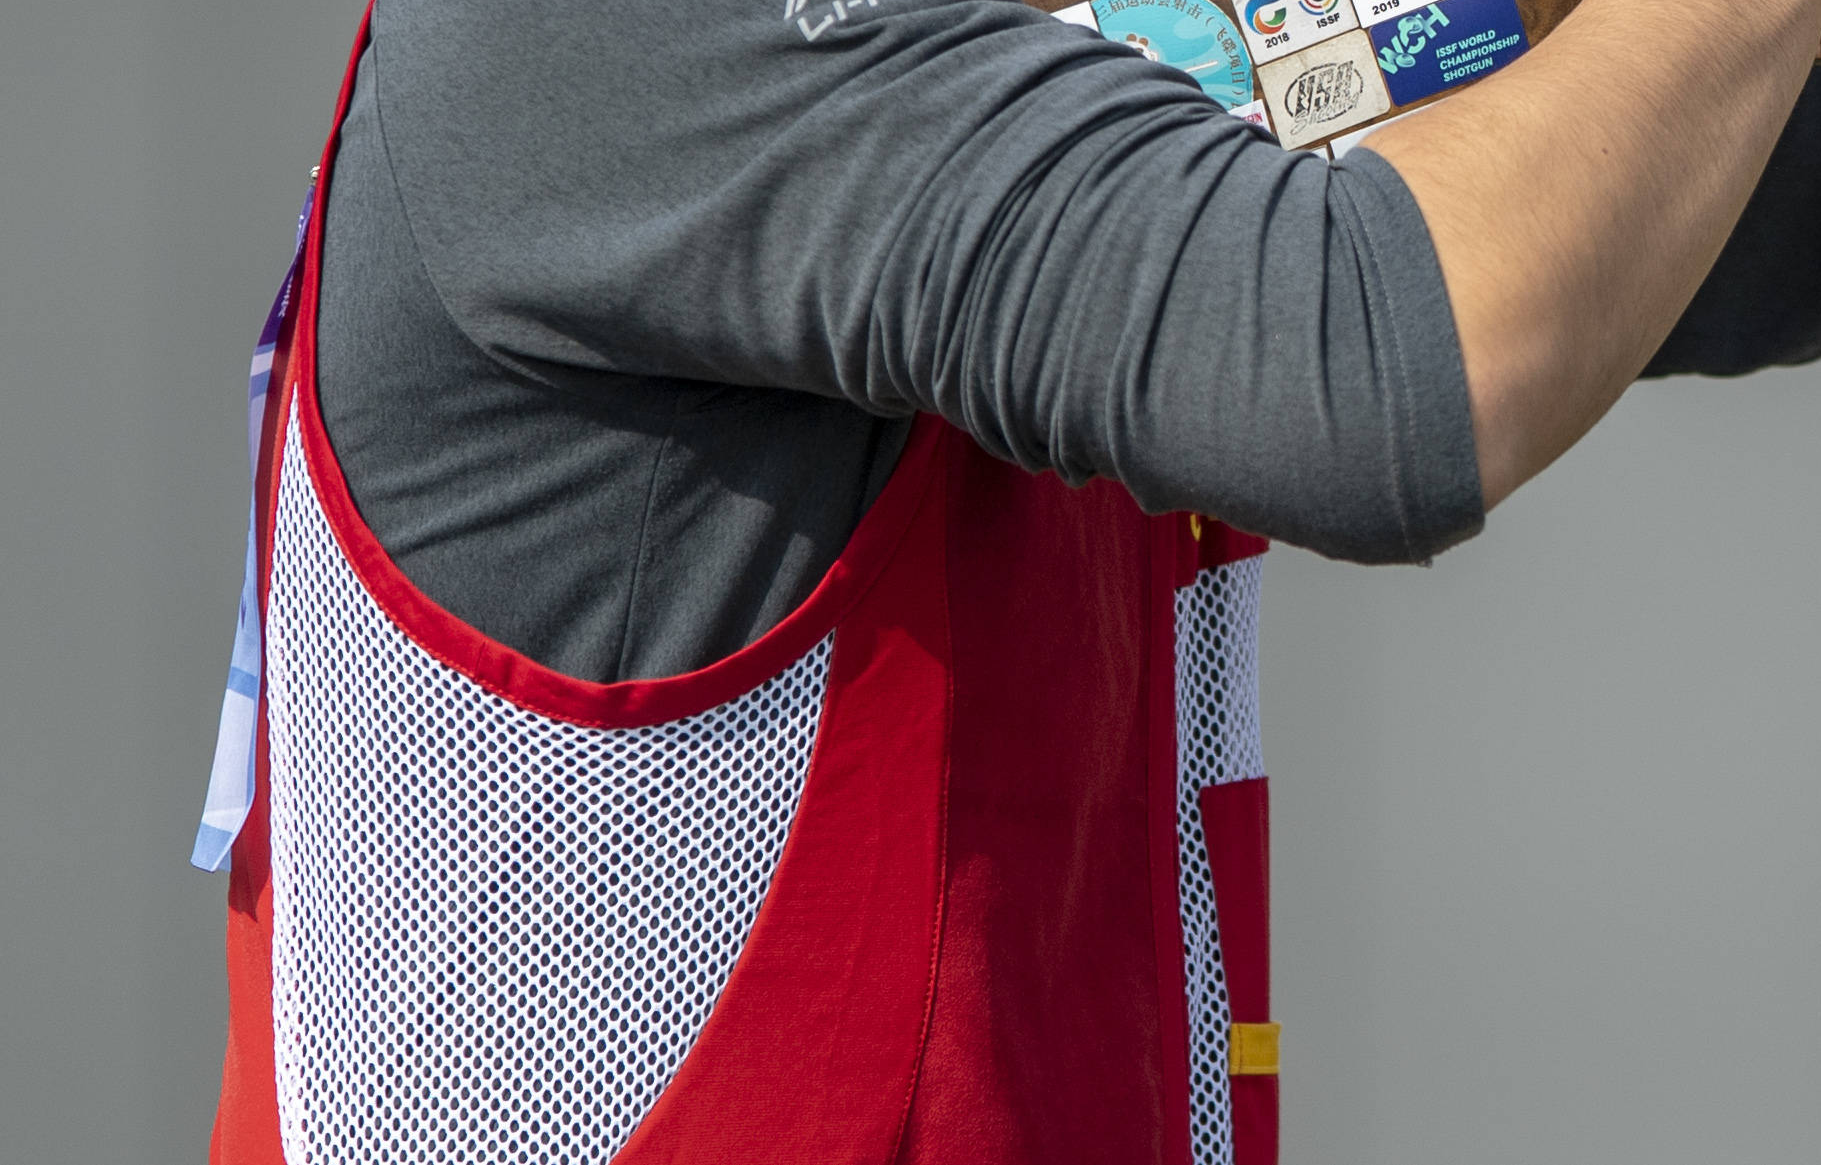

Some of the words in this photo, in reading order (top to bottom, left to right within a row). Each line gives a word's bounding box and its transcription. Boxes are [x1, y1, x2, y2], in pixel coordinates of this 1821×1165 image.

[1316, 13, 1341, 28] ISSF
[1265, 32, 1291, 49] 2018
[1436, 43, 1458, 59] ISSF
[1458, 29, 1496, 51] WORLD
[1439, 34, 1520, 70] CHAMPIONSHIP
[1443, 57, 1494, 82] SHOTGUN
